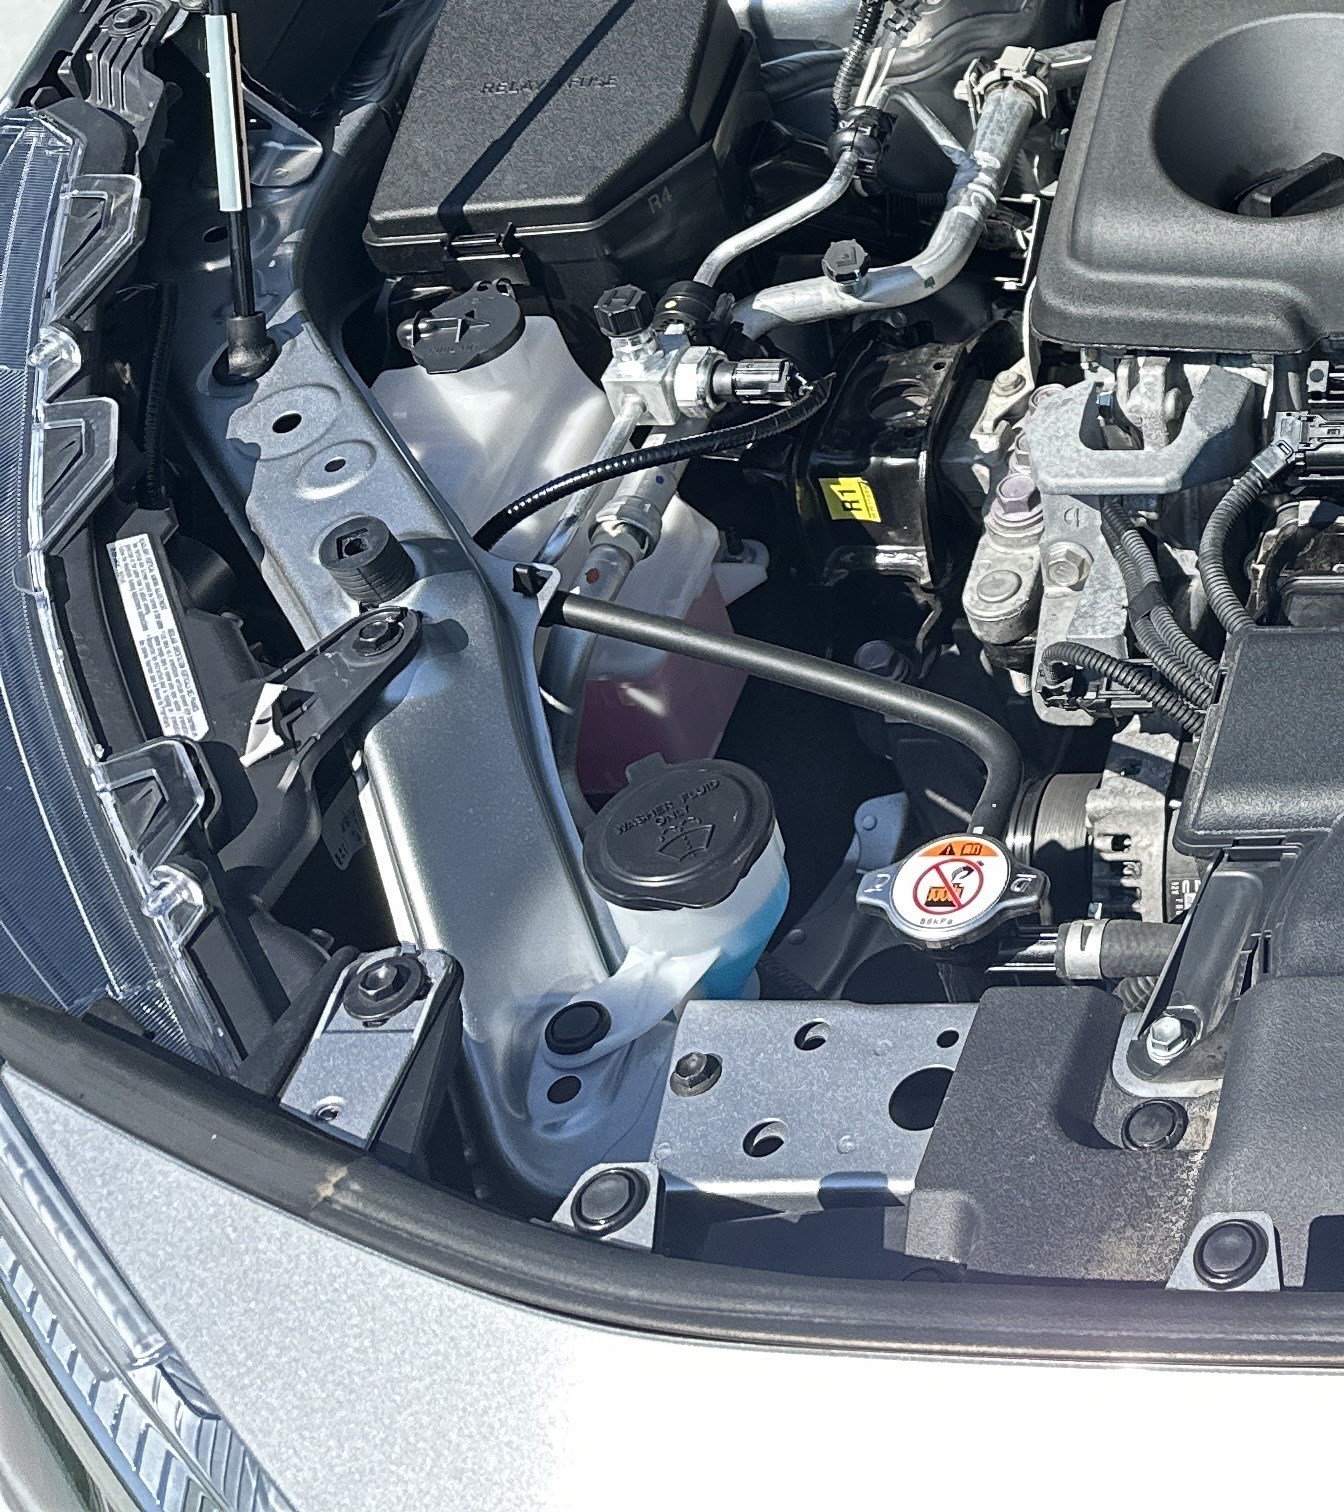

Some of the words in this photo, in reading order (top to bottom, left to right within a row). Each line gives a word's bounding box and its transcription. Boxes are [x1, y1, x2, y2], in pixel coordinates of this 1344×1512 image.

[647, 187, 674, 215] R4
[838, 489, 863, 512] R1
[616, 800, 675, 835] WASHER
[682, 779, 721, 804] FLUID
[655, 805, 690, 826] ONLY
